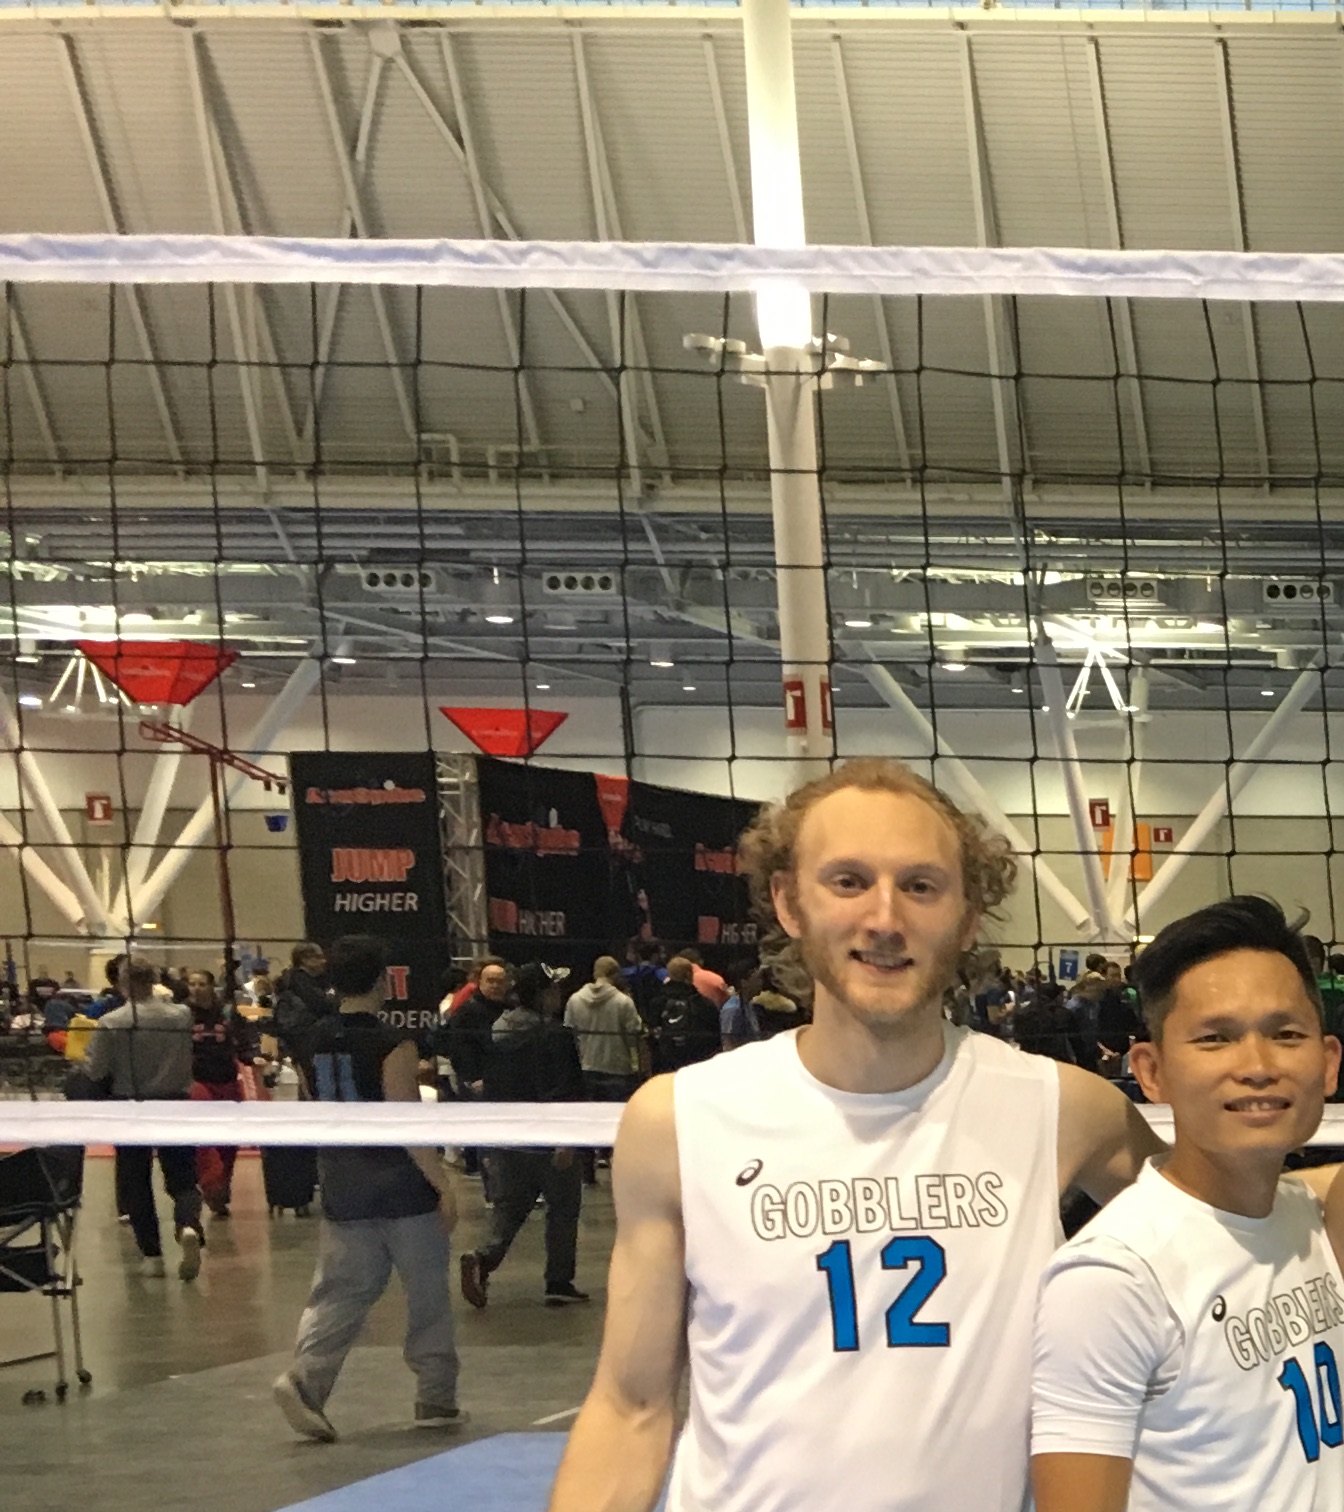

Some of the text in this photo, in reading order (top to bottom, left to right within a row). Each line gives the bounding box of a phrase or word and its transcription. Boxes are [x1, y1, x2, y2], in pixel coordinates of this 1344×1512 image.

[330, 847, 416, 883] JUMP
[334, 891, 419, 912] HIGHER
[382, 965, 410, 1000] IT
[1065, 961, 1073, 974] 7
[376, 1010, 433, 1029] RDER
[750, 1171, 1009, 1242] GOBBLERS
[815, 1235, 951, 1352] 12
[1276, 1340, 1344, 1463] 10
